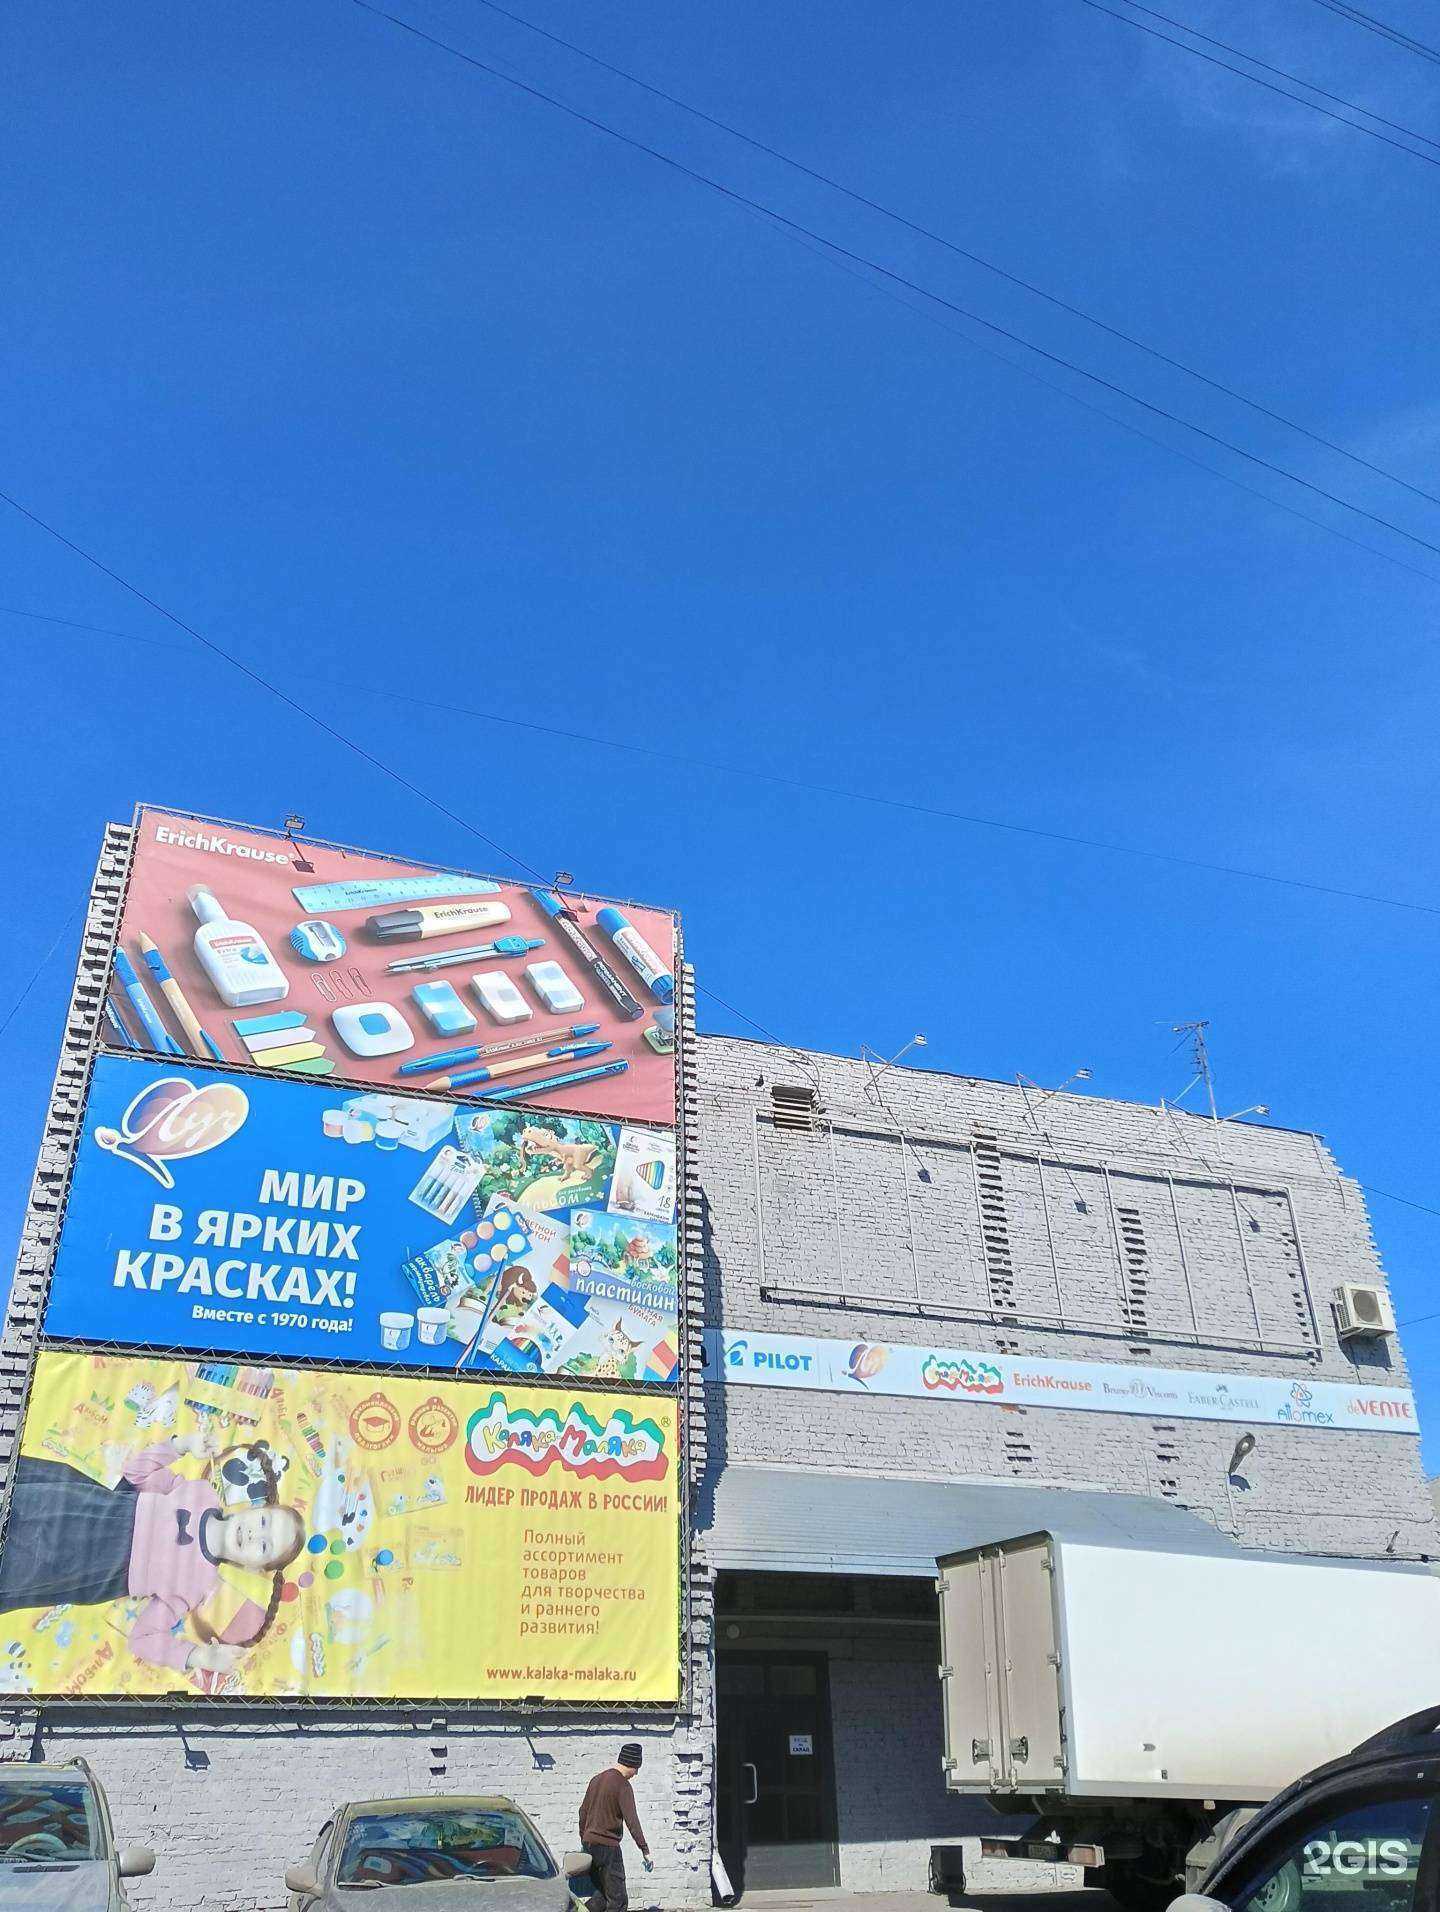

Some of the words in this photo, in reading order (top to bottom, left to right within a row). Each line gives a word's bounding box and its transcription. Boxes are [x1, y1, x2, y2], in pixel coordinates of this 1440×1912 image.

[155, 825, 290, 866] ErichKrause
[433, 906, 489, 919] ErichKrause
[258, 1168, 366, 1212] МИР
[149, 1203, 183, 1242] В
[193, 1209, 362, 1261] ЯРКИХ
[112, 1250, 358, 1309] КРАСКАХ!
[576, 1277, 675, 1312] пластилин
[192, 1304, 254, 1325] Вместе
[257, 1313, 267, 1326] с
[270, 1312, 308, 1329] 1970
[311, 1316, 354, 1334] года!
[754, 1352, 812, 1371] PILOT
[1013, 1373, 1092, 1392] ErichKrause
[464, 1485, 515, 1506] ЛИДЕР
[520, 1488, 582, 1508] ПРОДАЖ
[588, 1492, 598, 1510] В
[603, 1494, 668, 1512] РОССИИ!
[524, 1529, 586, 1546] Полный
[523, 1550, 624, 1568] ассортимент
[522, 1568, 586, 1582] товаров
[521, 1587, 551, 1600] для
[559, 1588, 646, 1601] творчества
[520, 1604, 530, 1616] и
[536, 1603, 600, 1618] раннего
[520, 1620, 600, 1636] развития!
[486, 1665, 637, 1682] www.kalaka-malaka.ru
